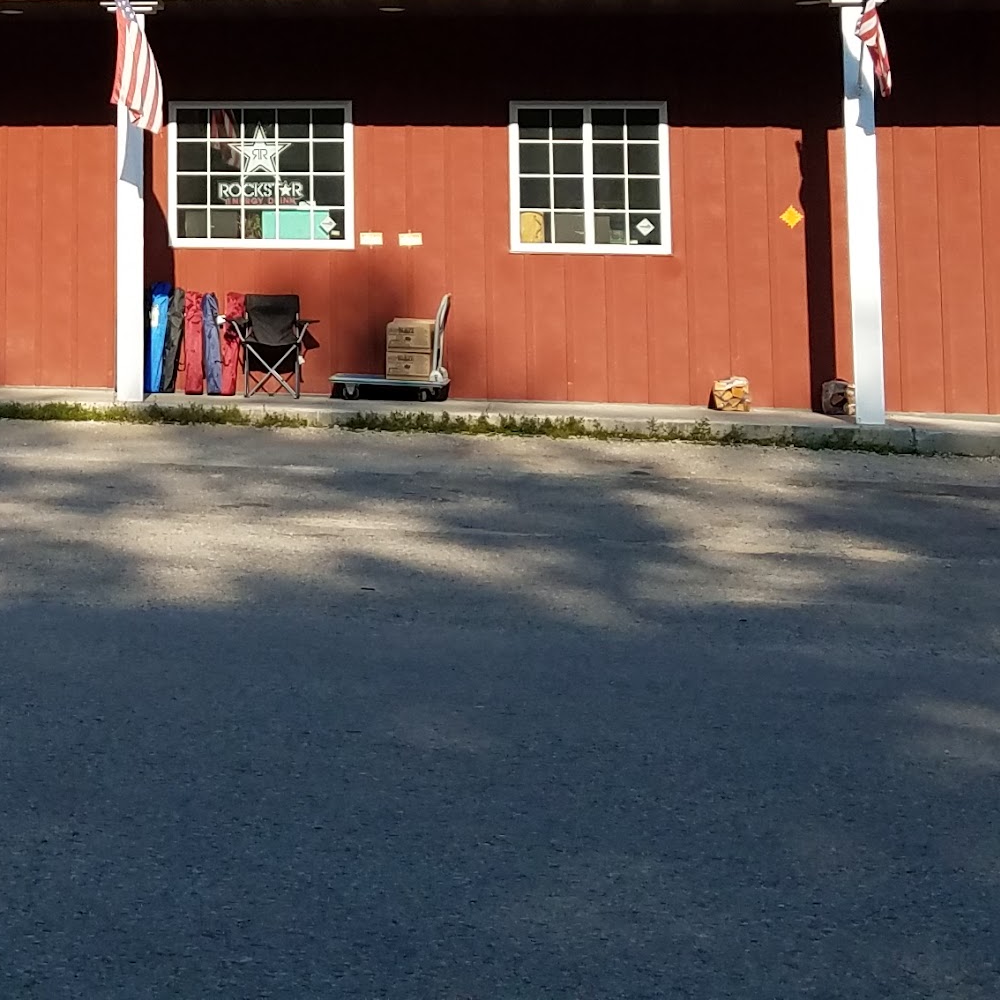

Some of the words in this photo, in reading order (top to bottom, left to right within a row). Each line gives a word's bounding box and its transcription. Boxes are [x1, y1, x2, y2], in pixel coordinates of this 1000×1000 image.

[217, 181, 304, 198] ROCKSAR
[225, 197, 264, 205] ENRGY
[268, 197, 297, 205] DINK
